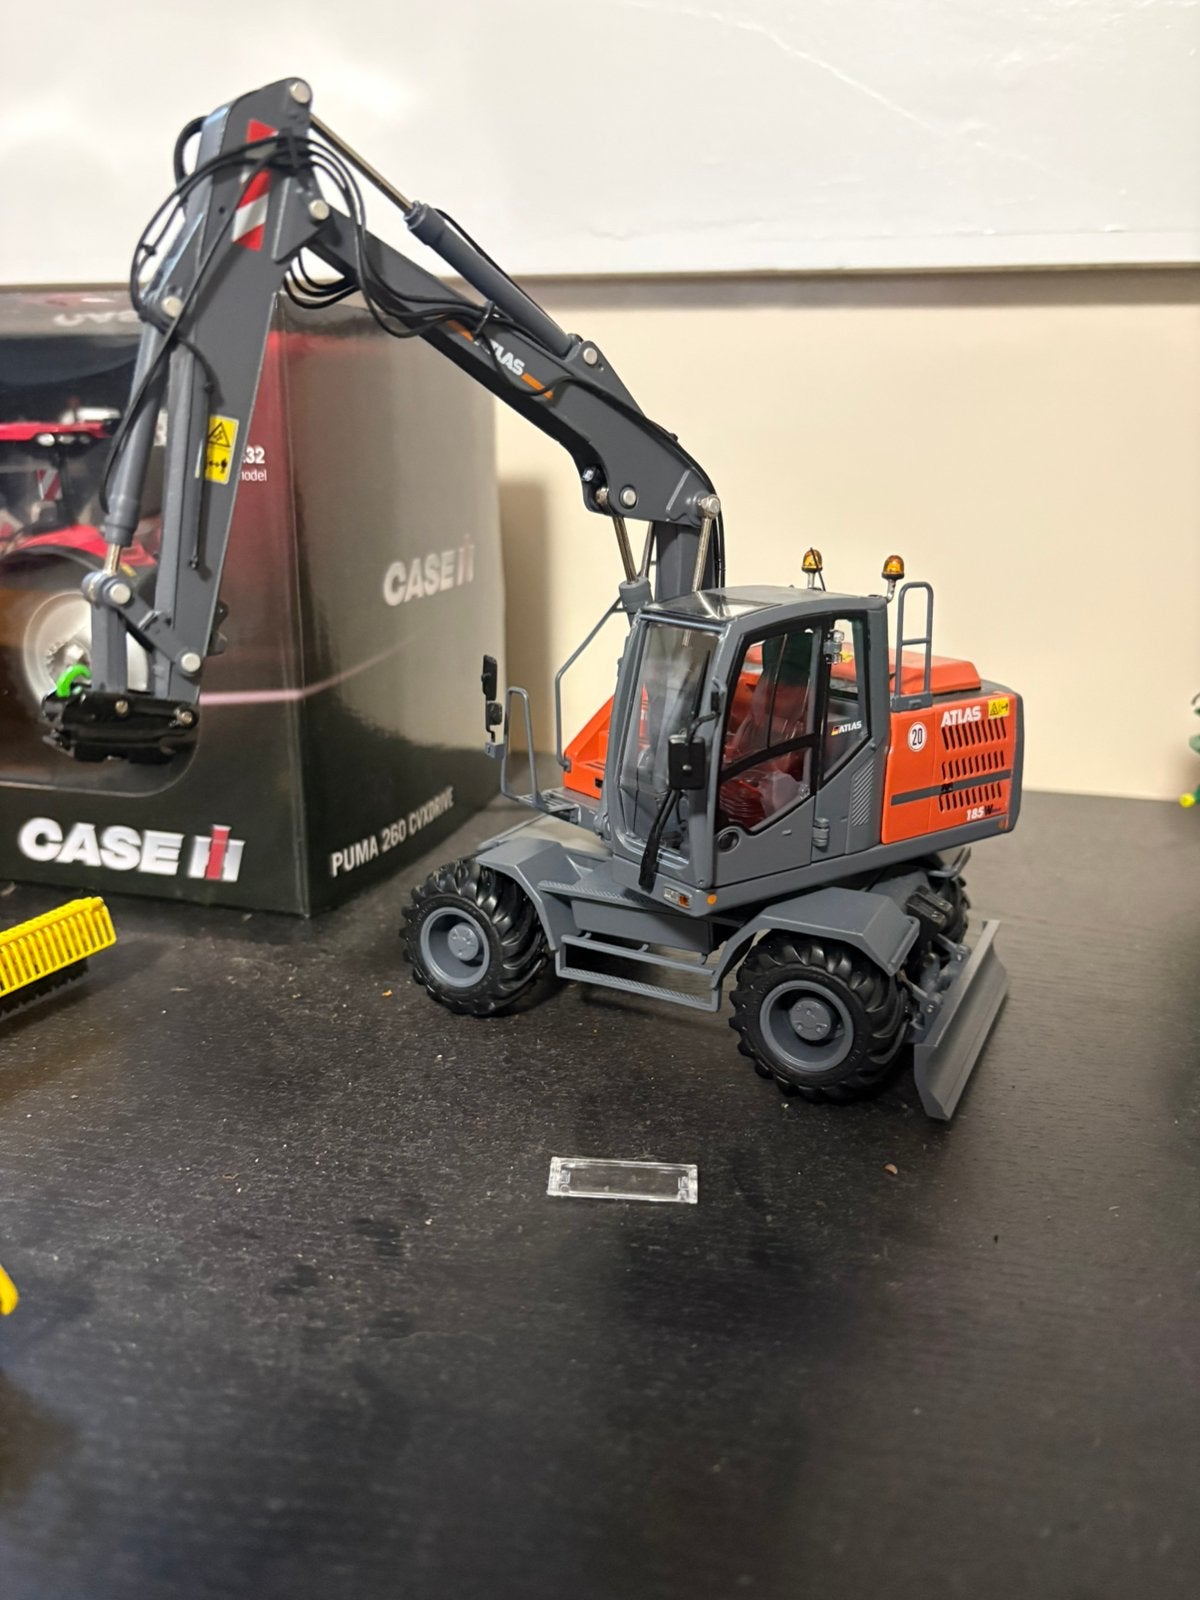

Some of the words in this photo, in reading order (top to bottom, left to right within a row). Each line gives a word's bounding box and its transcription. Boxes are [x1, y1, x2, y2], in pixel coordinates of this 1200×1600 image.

[383, 549, 455, 607] CASE
[838, 720, 863, 734] ATLAS
[941, 705, 982, 728] ATLAS
[911, 727, 924, 747] 20
[17, 816, 186, 876] CASE
[331, 834, 379, 878] PUMA
[381, 818, 407, 854] 260
[407, 785, 455, 836] CVXDRIVE
